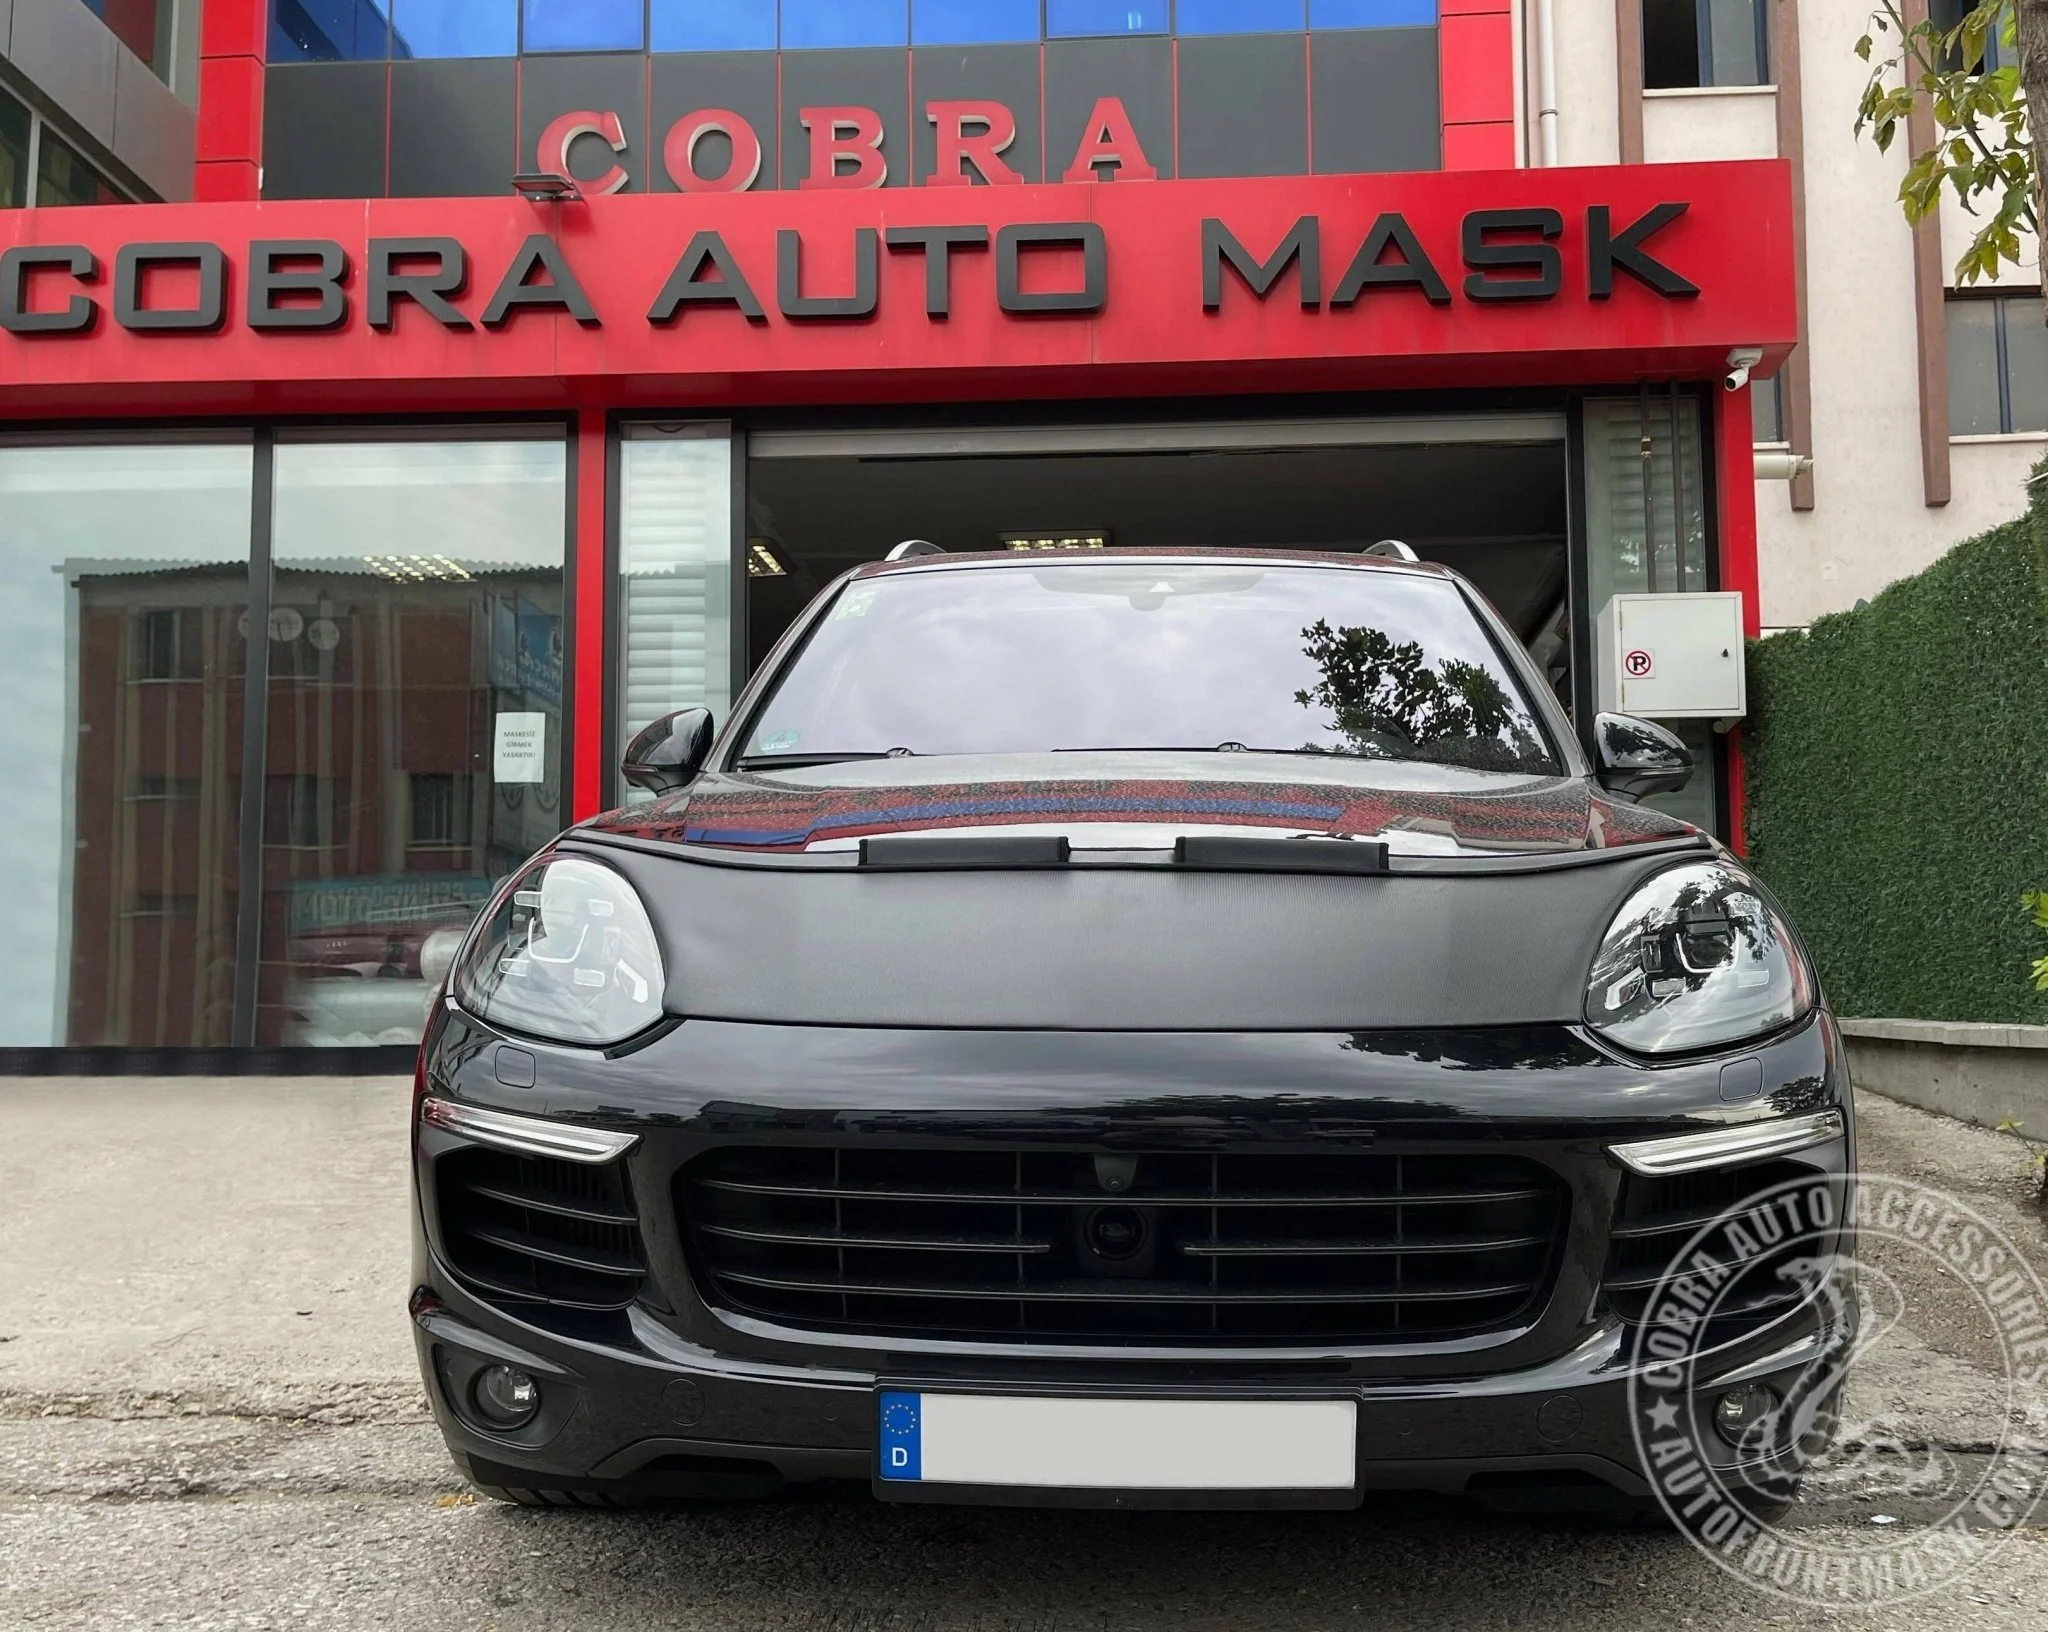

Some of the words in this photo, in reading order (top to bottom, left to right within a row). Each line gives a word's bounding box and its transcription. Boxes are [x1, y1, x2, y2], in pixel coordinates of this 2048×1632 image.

[537, 96, 1158, 195] COBRA
[0, 234, 602, 333] COBRA
[646, 222, 1108, 327] AUTO
[1201, 202, 1701, 313] MASK
[892, 1447, 908, 1467] D
